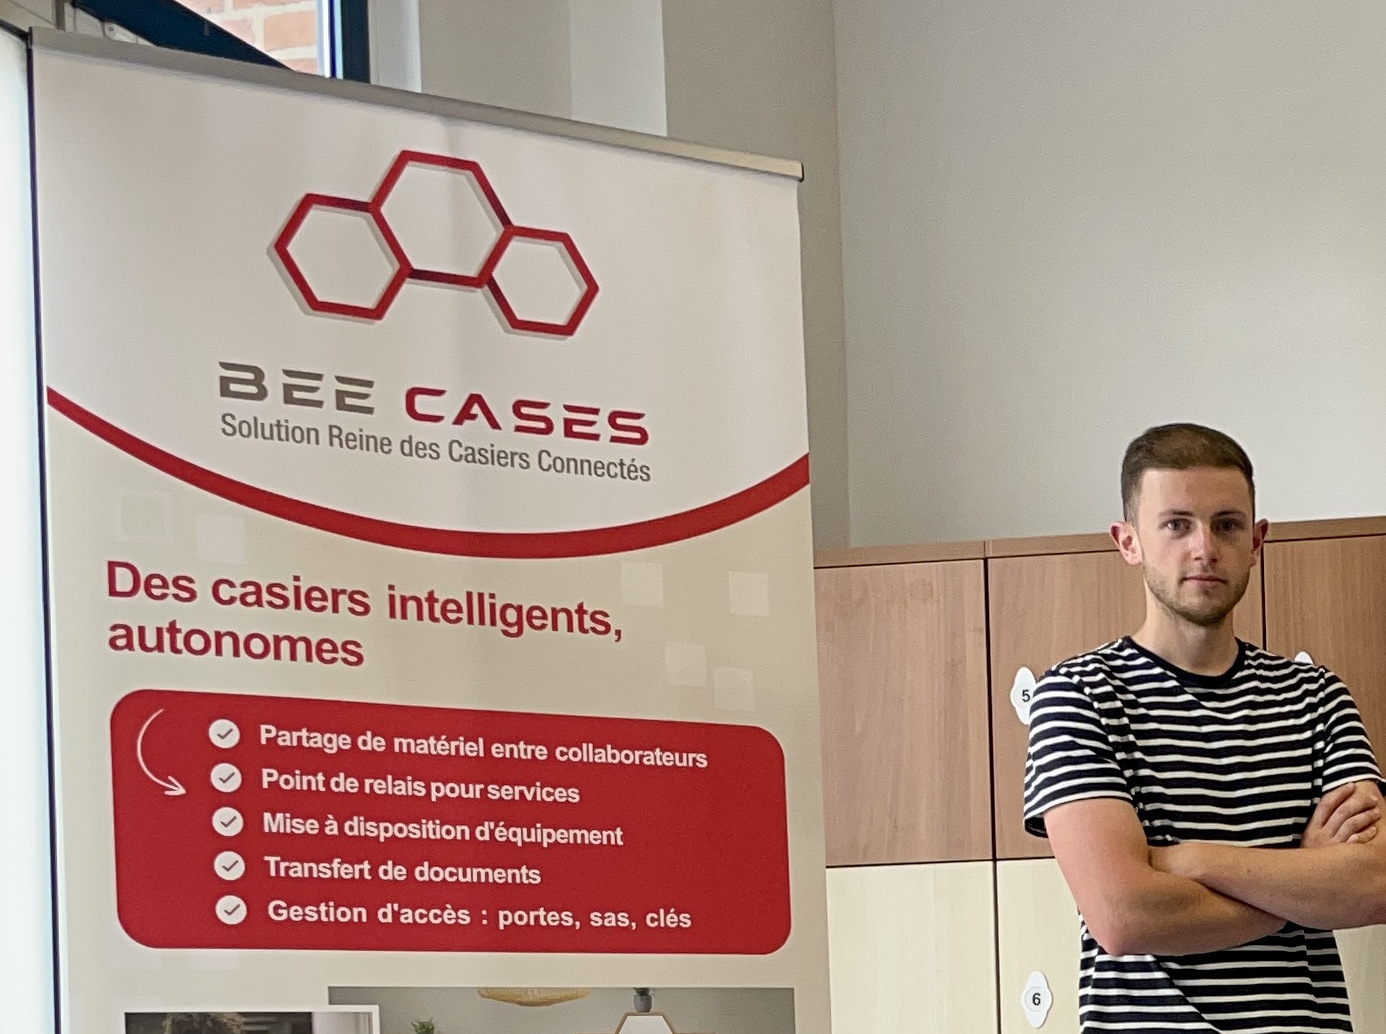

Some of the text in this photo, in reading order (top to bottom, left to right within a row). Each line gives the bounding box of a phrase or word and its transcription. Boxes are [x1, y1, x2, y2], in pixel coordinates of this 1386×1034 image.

[219, 361, 648, 445] BEE CASES
[221, 412, 651, 483] Solution Reine des Casiers Connectés
[107, 560, 622, 643] Des casiers intelligents,
[108, 619, 365, 667] autonomes
[1022, 689, 1031, 703] 5
[259, 724, 708, 768] Partage de matériel entre collaborateurs
[261, 768, 581, 803] Point de relais pour services
[263, 811, 624, 848] Mise à disposition d'équipement
[263, 855, 542, 885] Transfert de documents
[267, 899, 692, 931] Gestion d'accès : portes, sas, clés
[1032, 993, 1041, 1006] 6
